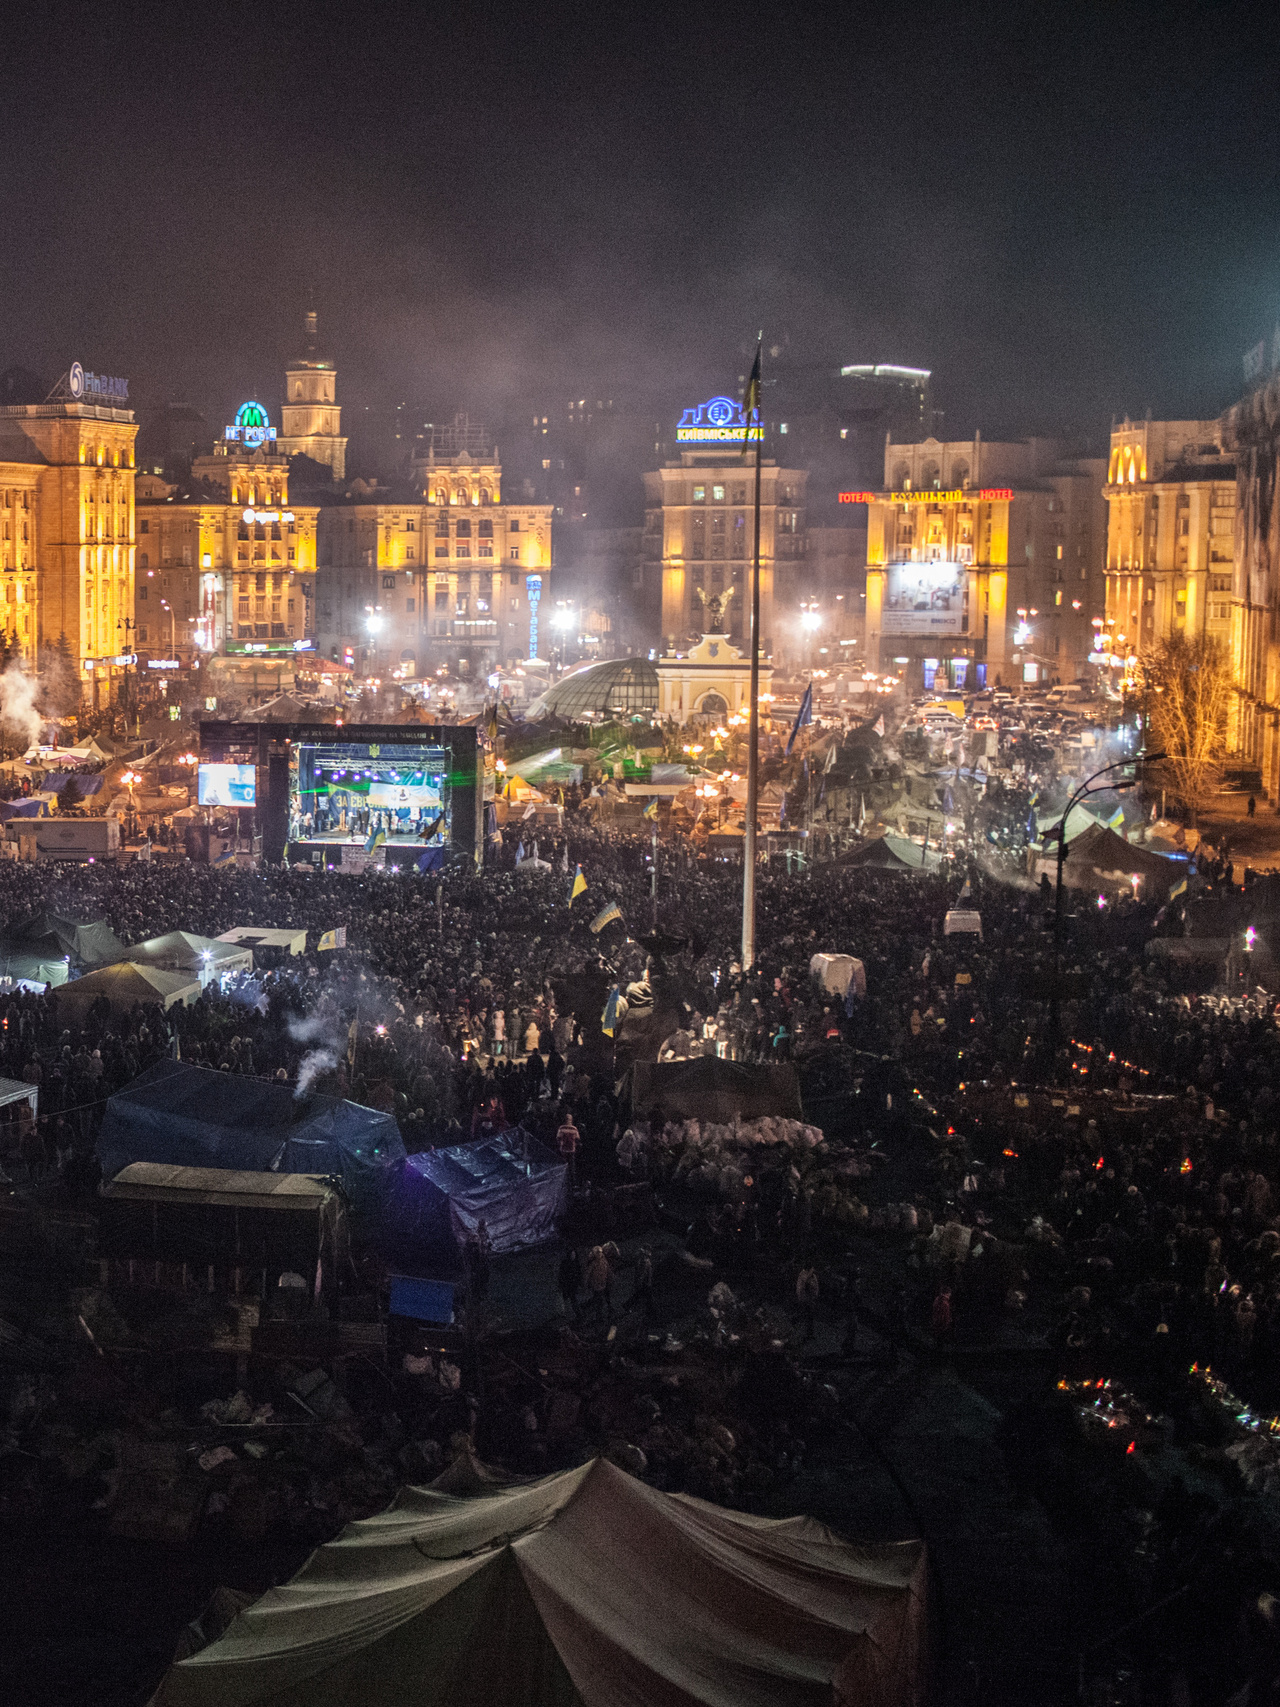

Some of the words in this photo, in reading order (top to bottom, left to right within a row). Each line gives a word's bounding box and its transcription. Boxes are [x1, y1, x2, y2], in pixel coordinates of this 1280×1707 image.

[83, 371, 129, 397] FinBANK
[838, 492, 875, 503] ГОТЕЛЬ
[891, 490, 963, 502] КОЗАЦЬКИЙ
[980, 489, 1014, 500] HOTEL
[337, 795, 348, 807] ЗА
